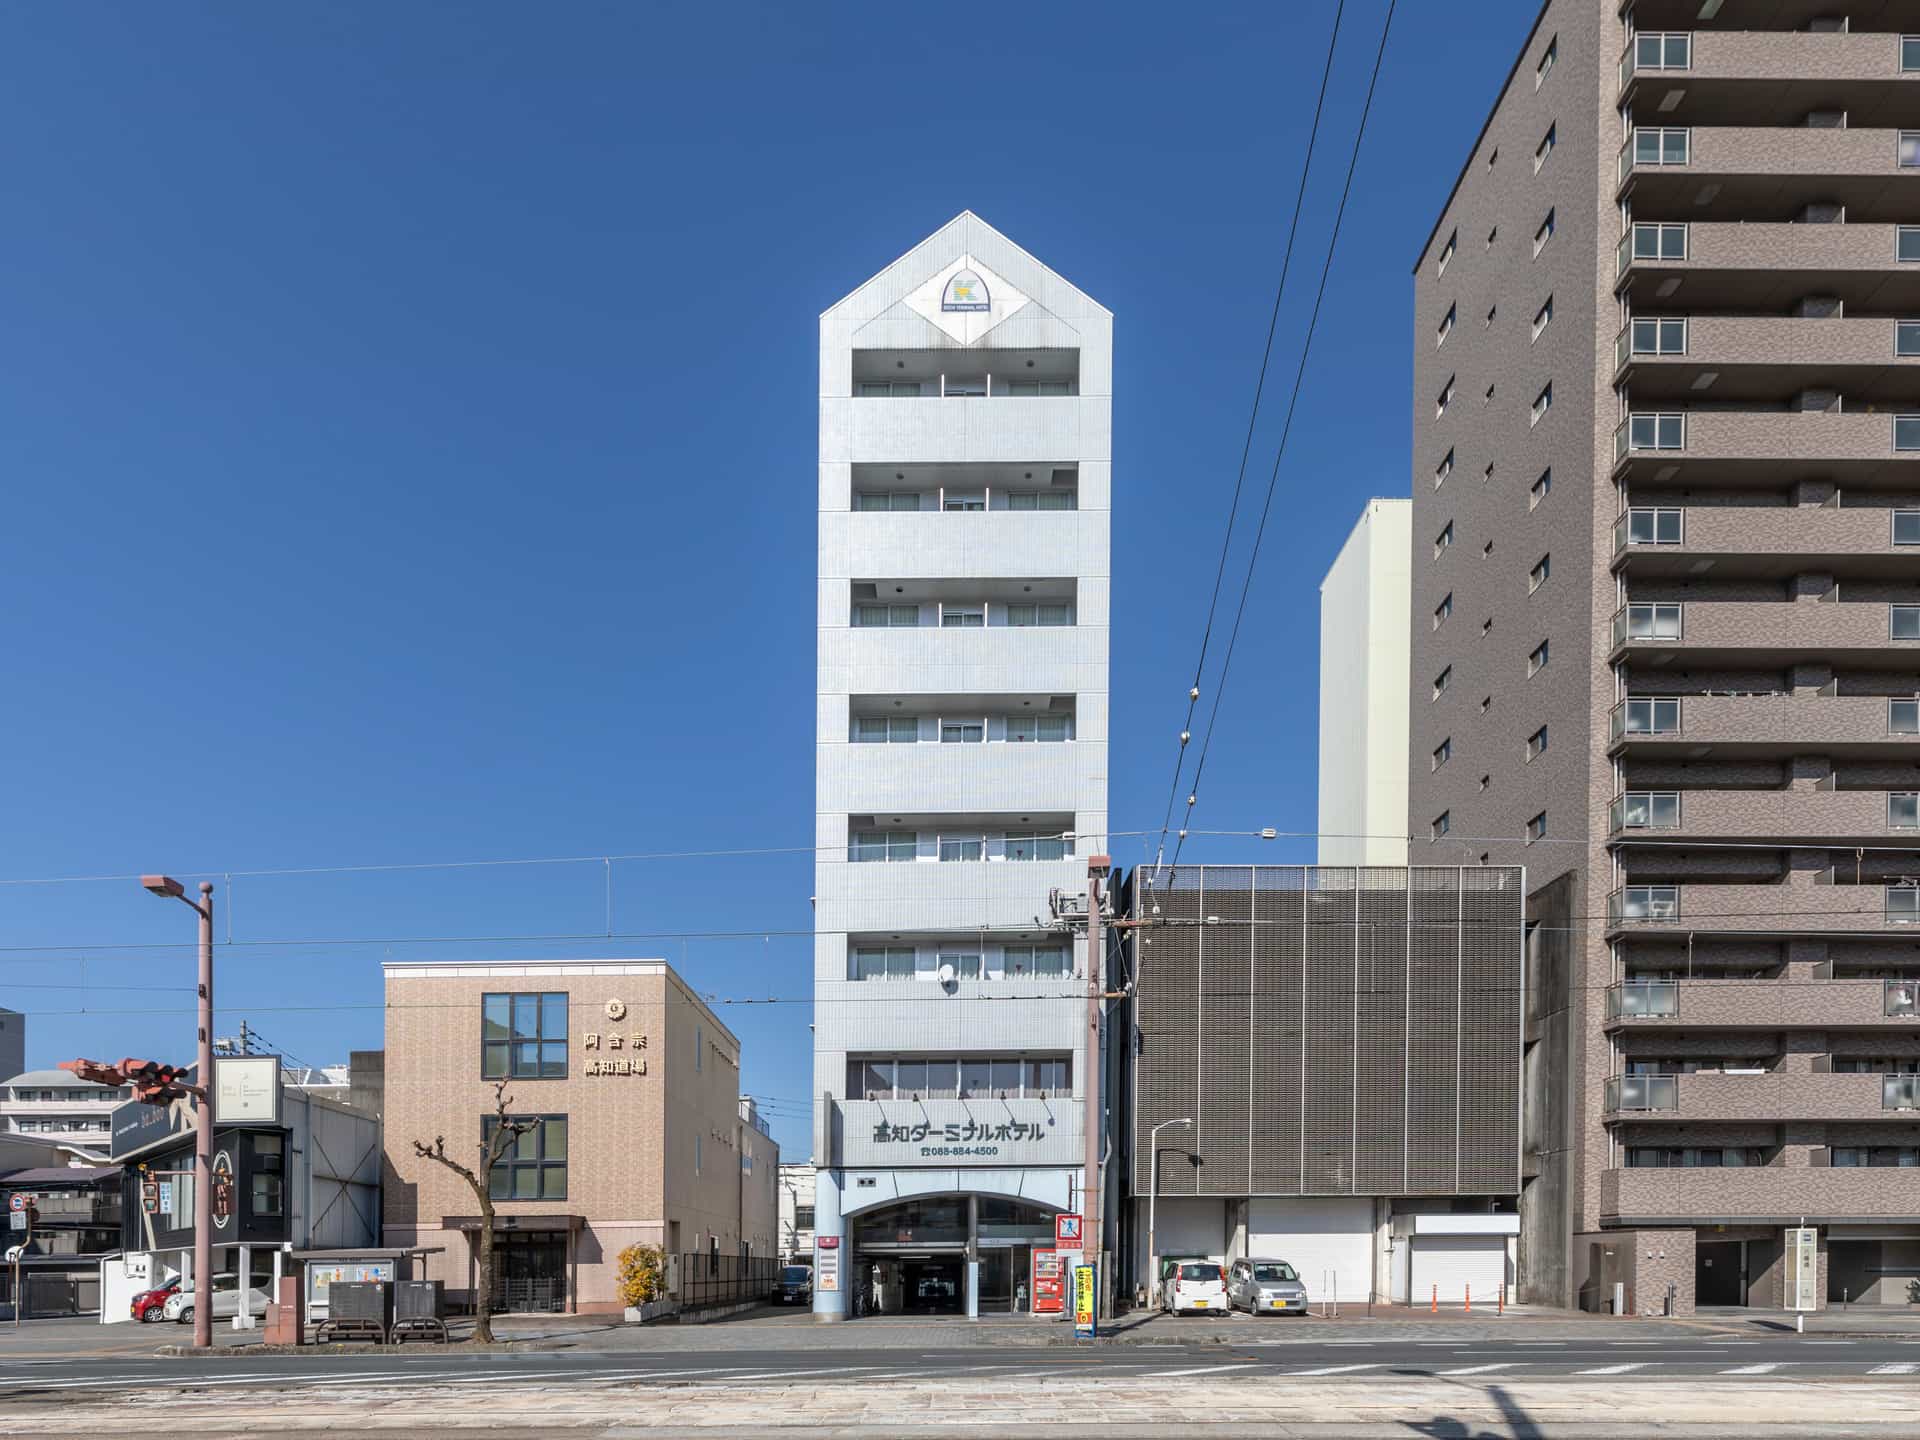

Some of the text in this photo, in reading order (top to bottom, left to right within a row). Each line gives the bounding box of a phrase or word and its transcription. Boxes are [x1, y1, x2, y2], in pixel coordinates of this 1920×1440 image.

[584, 1058, 647, 1077] 高知道場
[873, 1123, 1045, 1143] 高知ターミナルホテル
